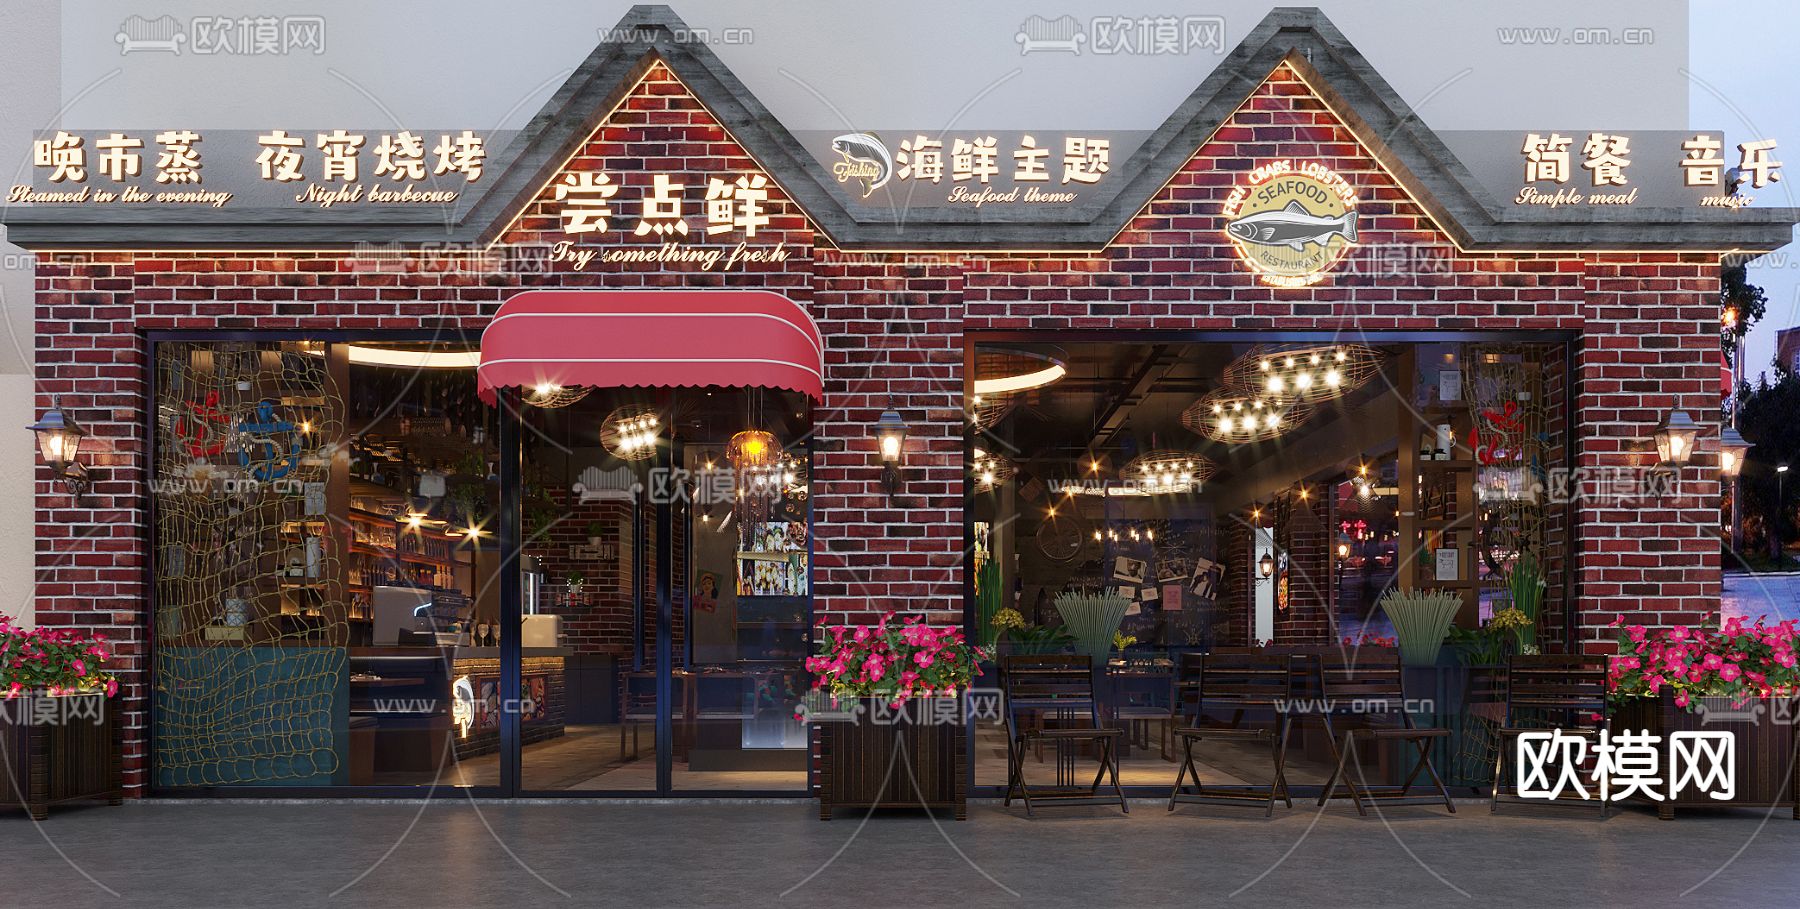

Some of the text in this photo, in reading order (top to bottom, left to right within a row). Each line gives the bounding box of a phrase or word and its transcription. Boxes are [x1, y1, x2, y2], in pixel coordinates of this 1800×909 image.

[34, 131, 202, 183] 晚市蒸
[256, 130, 486, 181] 夜宵烧烤
[896, 135, 1110, 184] 海鲜主题
[1520, 133, 1632, 186] 简餐
[1680, 135, 1784, 188] 音乐
[6, 184, 234, 208] Steamed in the evening
[295, 183, 460, 208] Night barbecue
[948, 186, 1078, 208] Seafood theme
[1222, 160, 1359, 216] FISH CRABS LOBSTERS
[1257, 180, 1328, 205] SEAFOOD
[1514, 187, 1638, 209] Simple meal
[1700, 192, 1754, 209] music
[555, 172, 770, 237] 尝点鲜
[549, 240, 791, 272] Try something fresh
[1260, 250, 1325, 270] RESTAURANT
